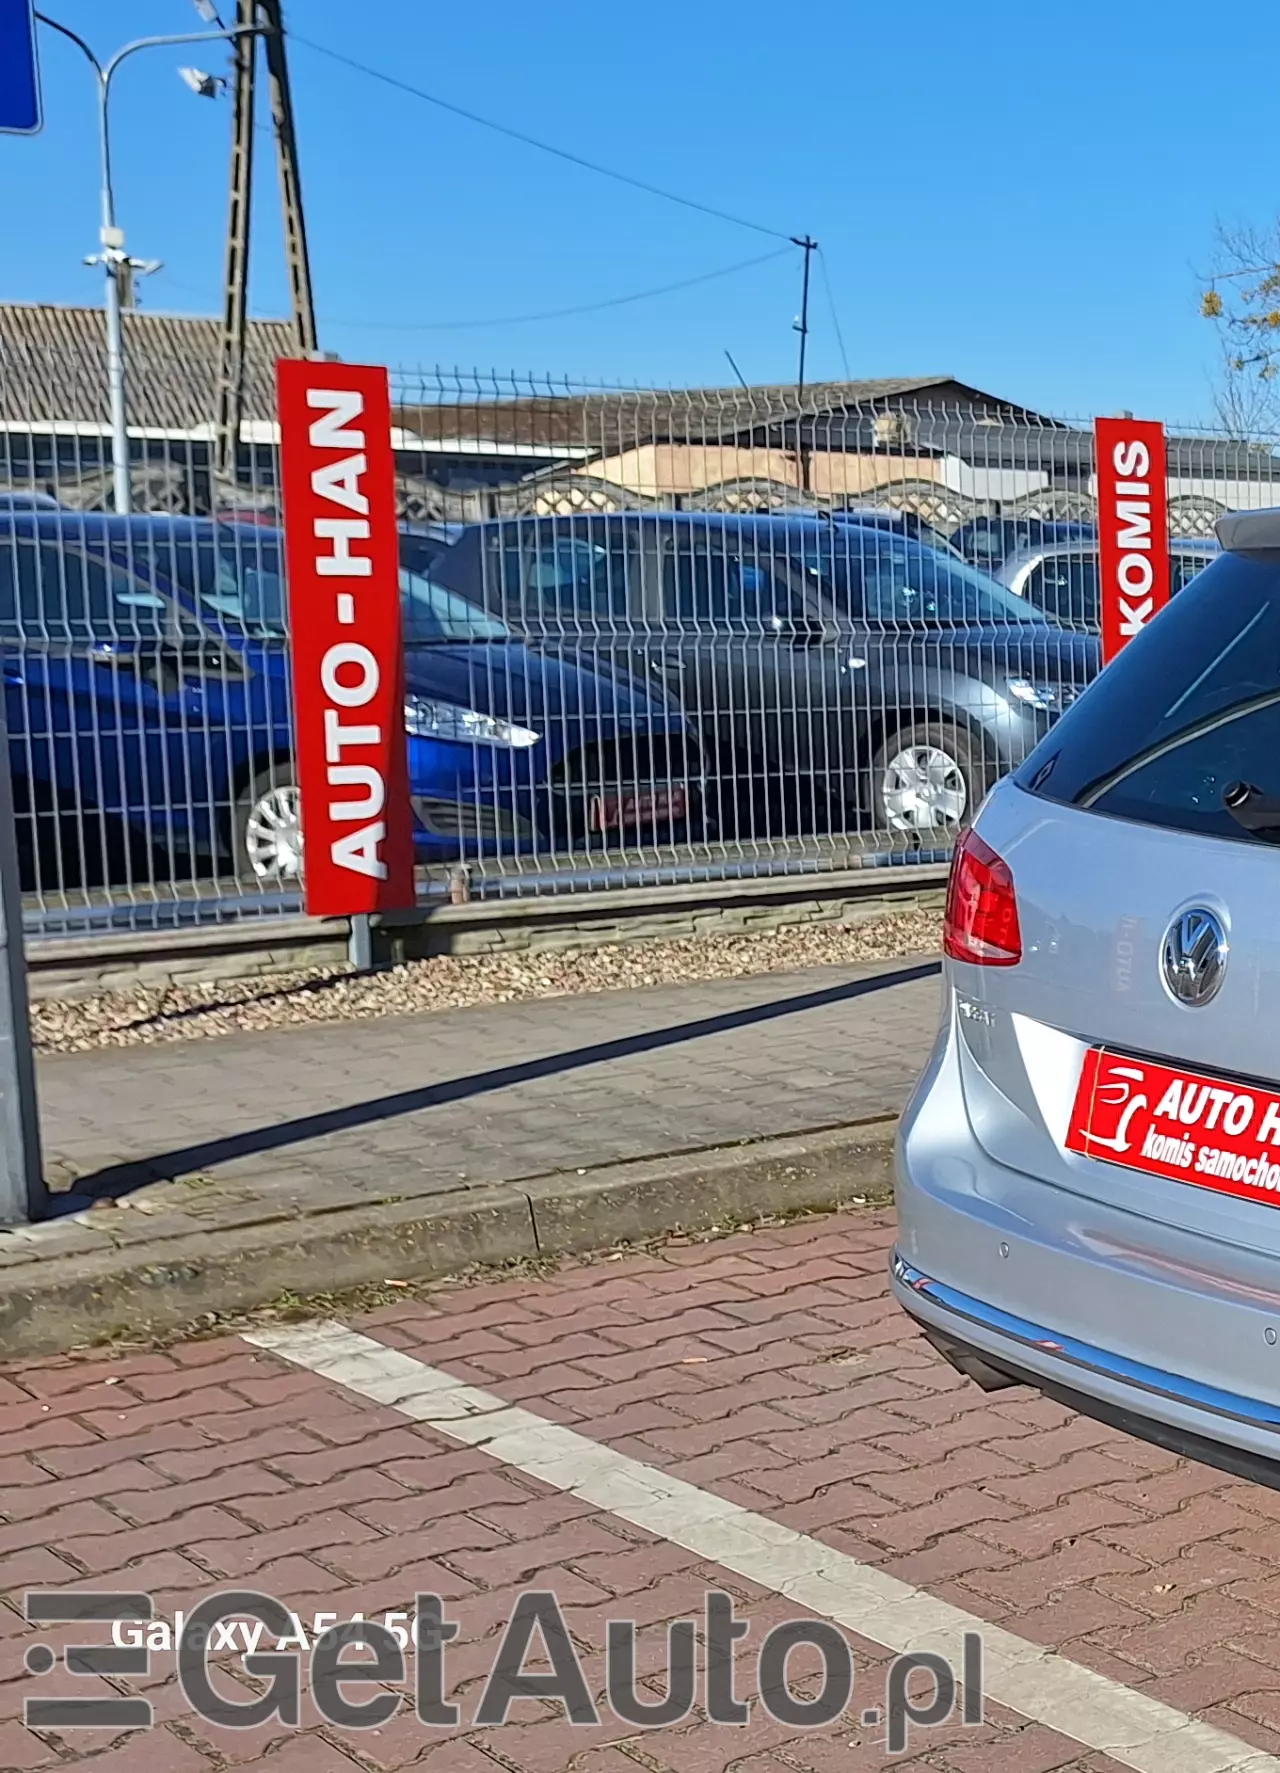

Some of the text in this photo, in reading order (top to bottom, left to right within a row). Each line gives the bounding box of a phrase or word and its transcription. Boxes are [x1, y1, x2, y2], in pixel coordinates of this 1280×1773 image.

[1113, 440, 1154, 637] KOMIS
[1154, 1079, 1254, 1135] AUTO
[1140, 1124, 1196, 1168] komis
